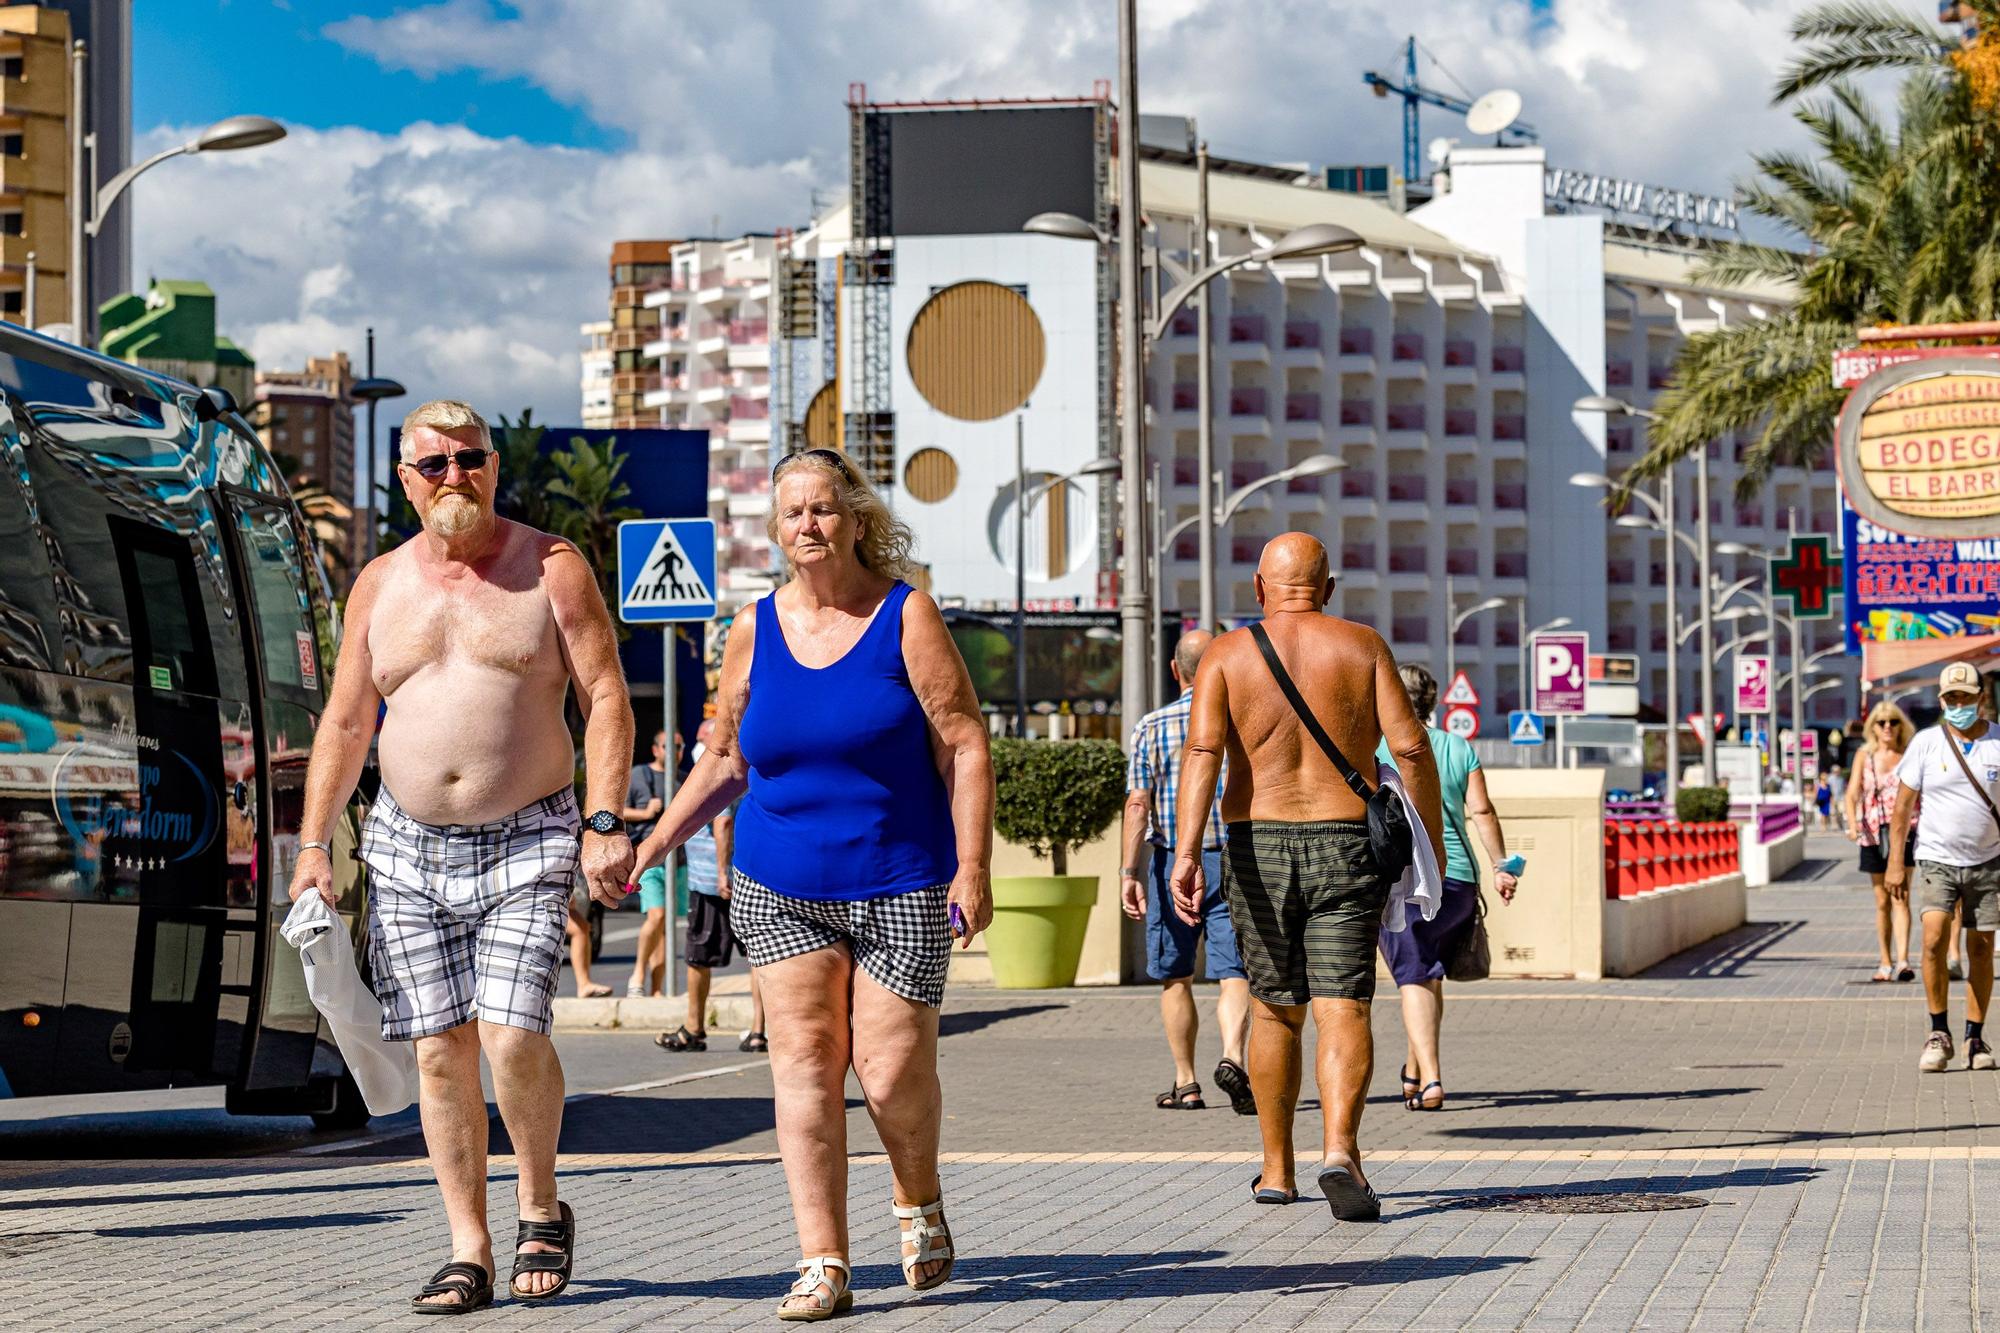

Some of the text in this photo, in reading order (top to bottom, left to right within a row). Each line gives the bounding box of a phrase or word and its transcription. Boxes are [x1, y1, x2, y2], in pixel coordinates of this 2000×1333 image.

[1921, 384, 1961, 403] WINE
[1965, 381, 2000, 399] BAR
[1903, 408, 1999, 429] OFF LICENCE
[1880, 434, 2000, 466] BODEG
[1889, 472, 2000, 497] EL BARR
[1857, 562, 1930, 578] COLD
[1857, 576, 1948, 595] BEACH
[1537, 644, 1572, 690] P
[1739, 660, 1759, 687] P
